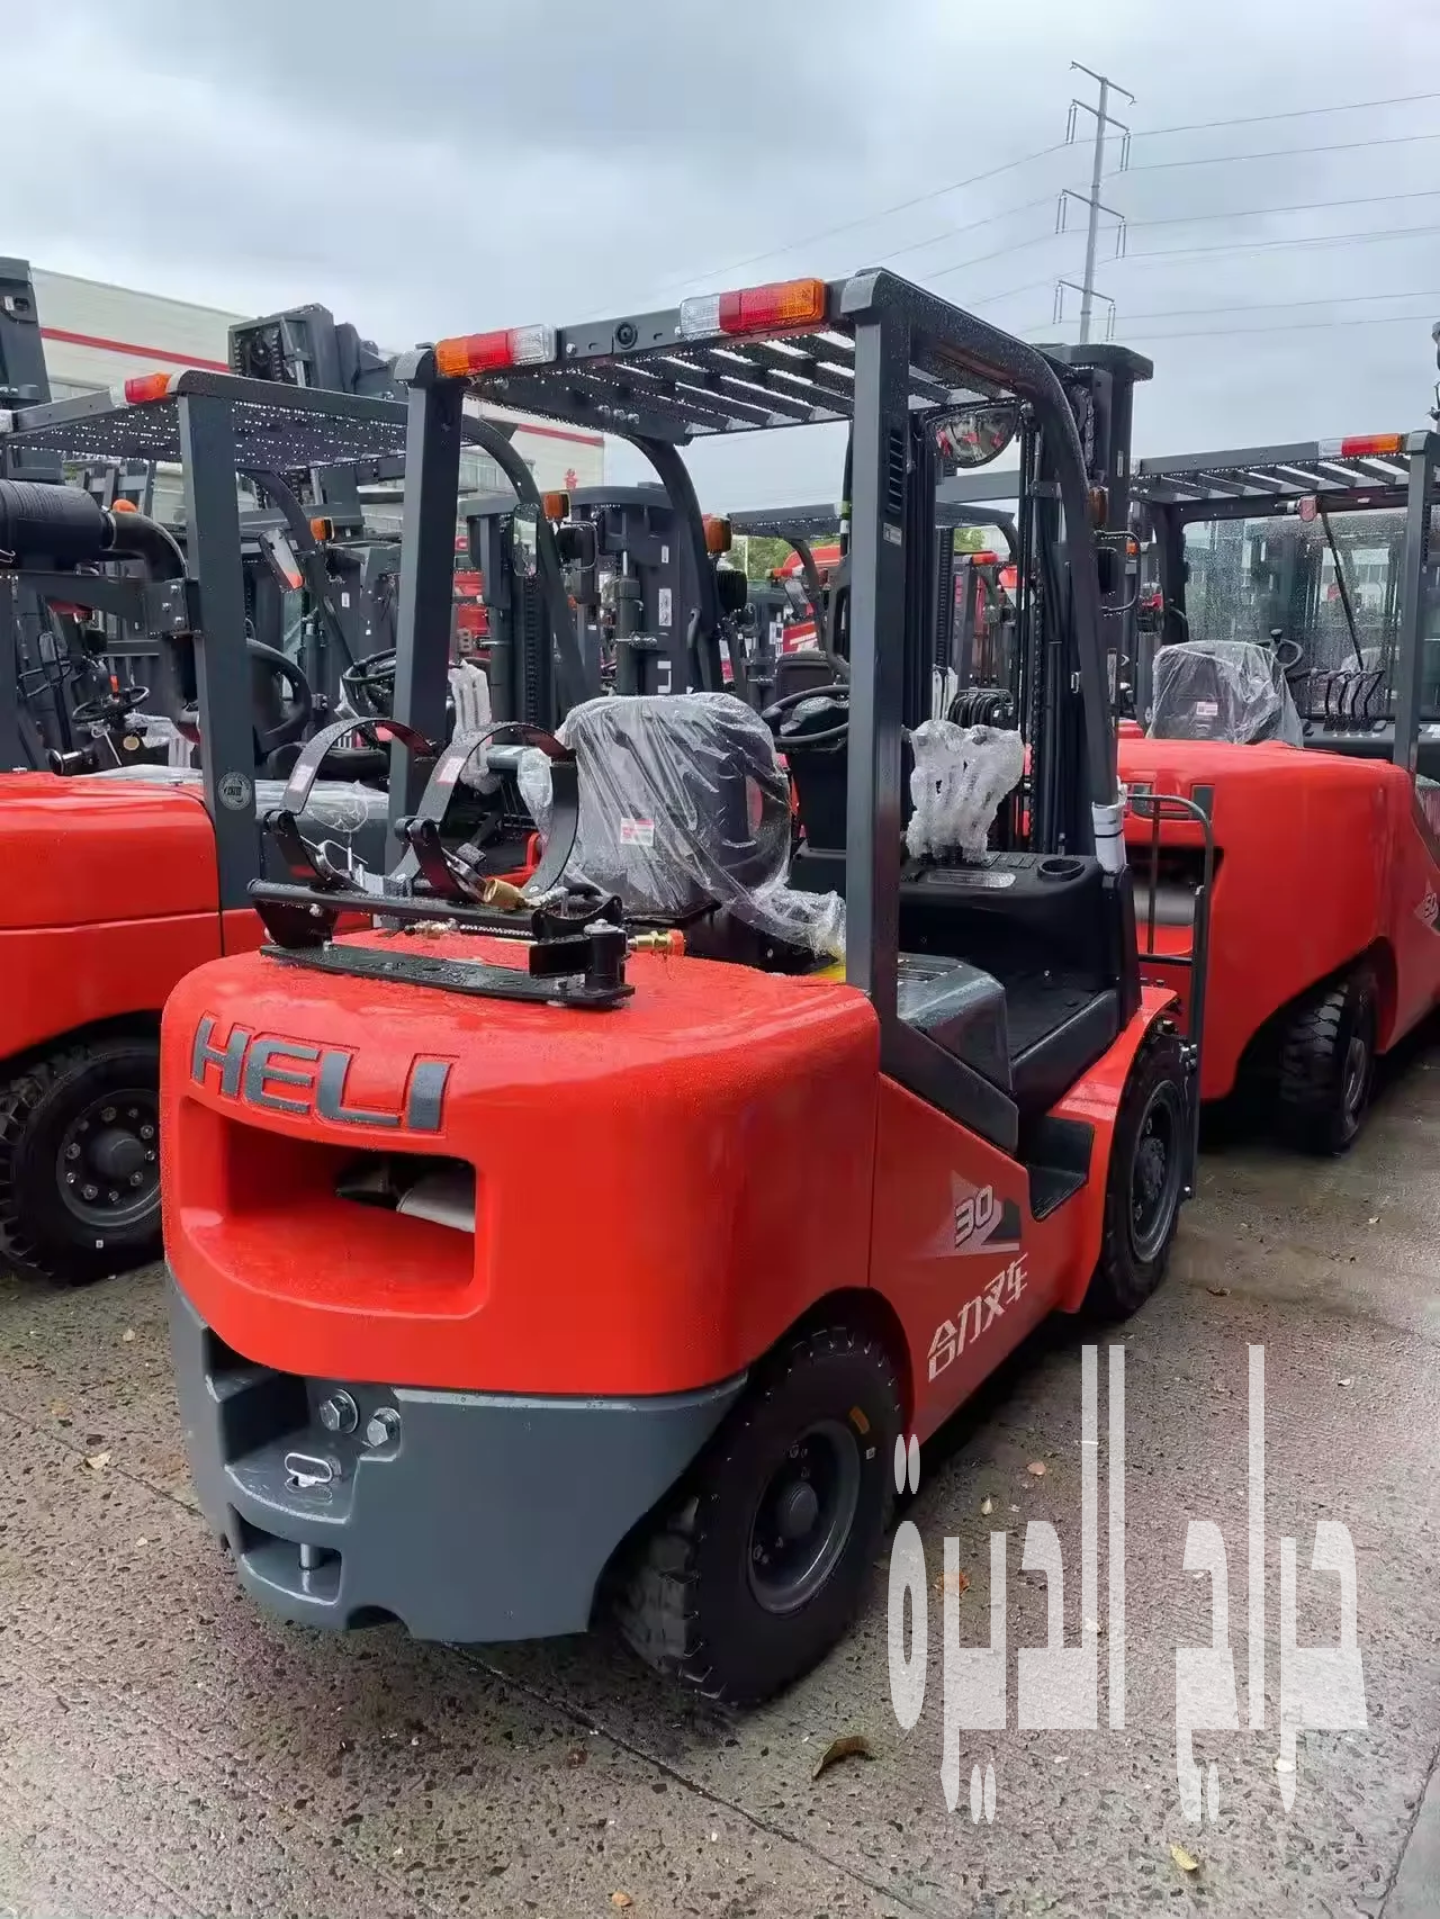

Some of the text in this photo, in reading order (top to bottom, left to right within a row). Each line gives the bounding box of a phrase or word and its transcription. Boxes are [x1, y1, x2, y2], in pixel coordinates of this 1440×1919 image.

[191, 1015, 451, 1130] HELI
[955, 1184, 993, 1249] 30
[927, 1252, 1029, 1382] 合力叉车
